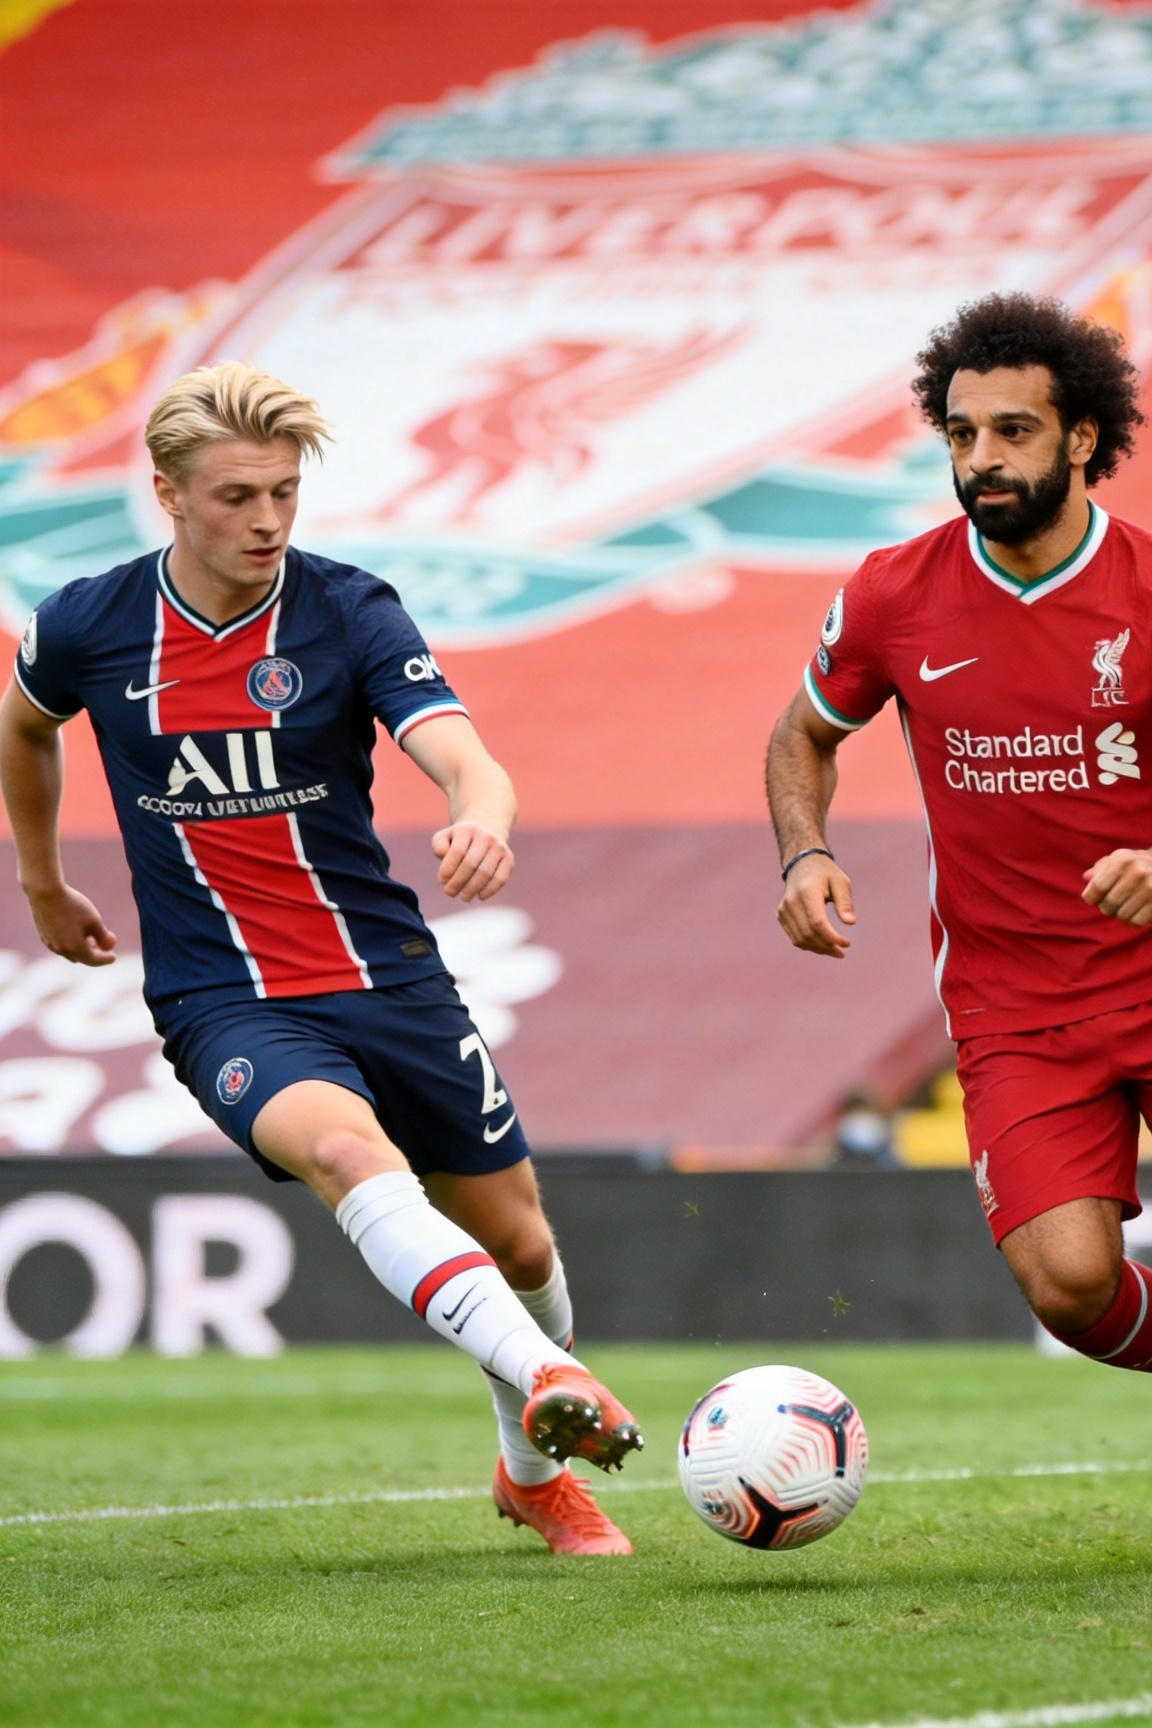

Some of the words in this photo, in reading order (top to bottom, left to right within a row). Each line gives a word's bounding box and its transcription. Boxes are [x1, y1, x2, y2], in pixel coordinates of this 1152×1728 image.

[945, 725, 1083, 758] Standard
[945, 760, 1090, 794] Chartered
[459, 1032, 507, 1114] 2
